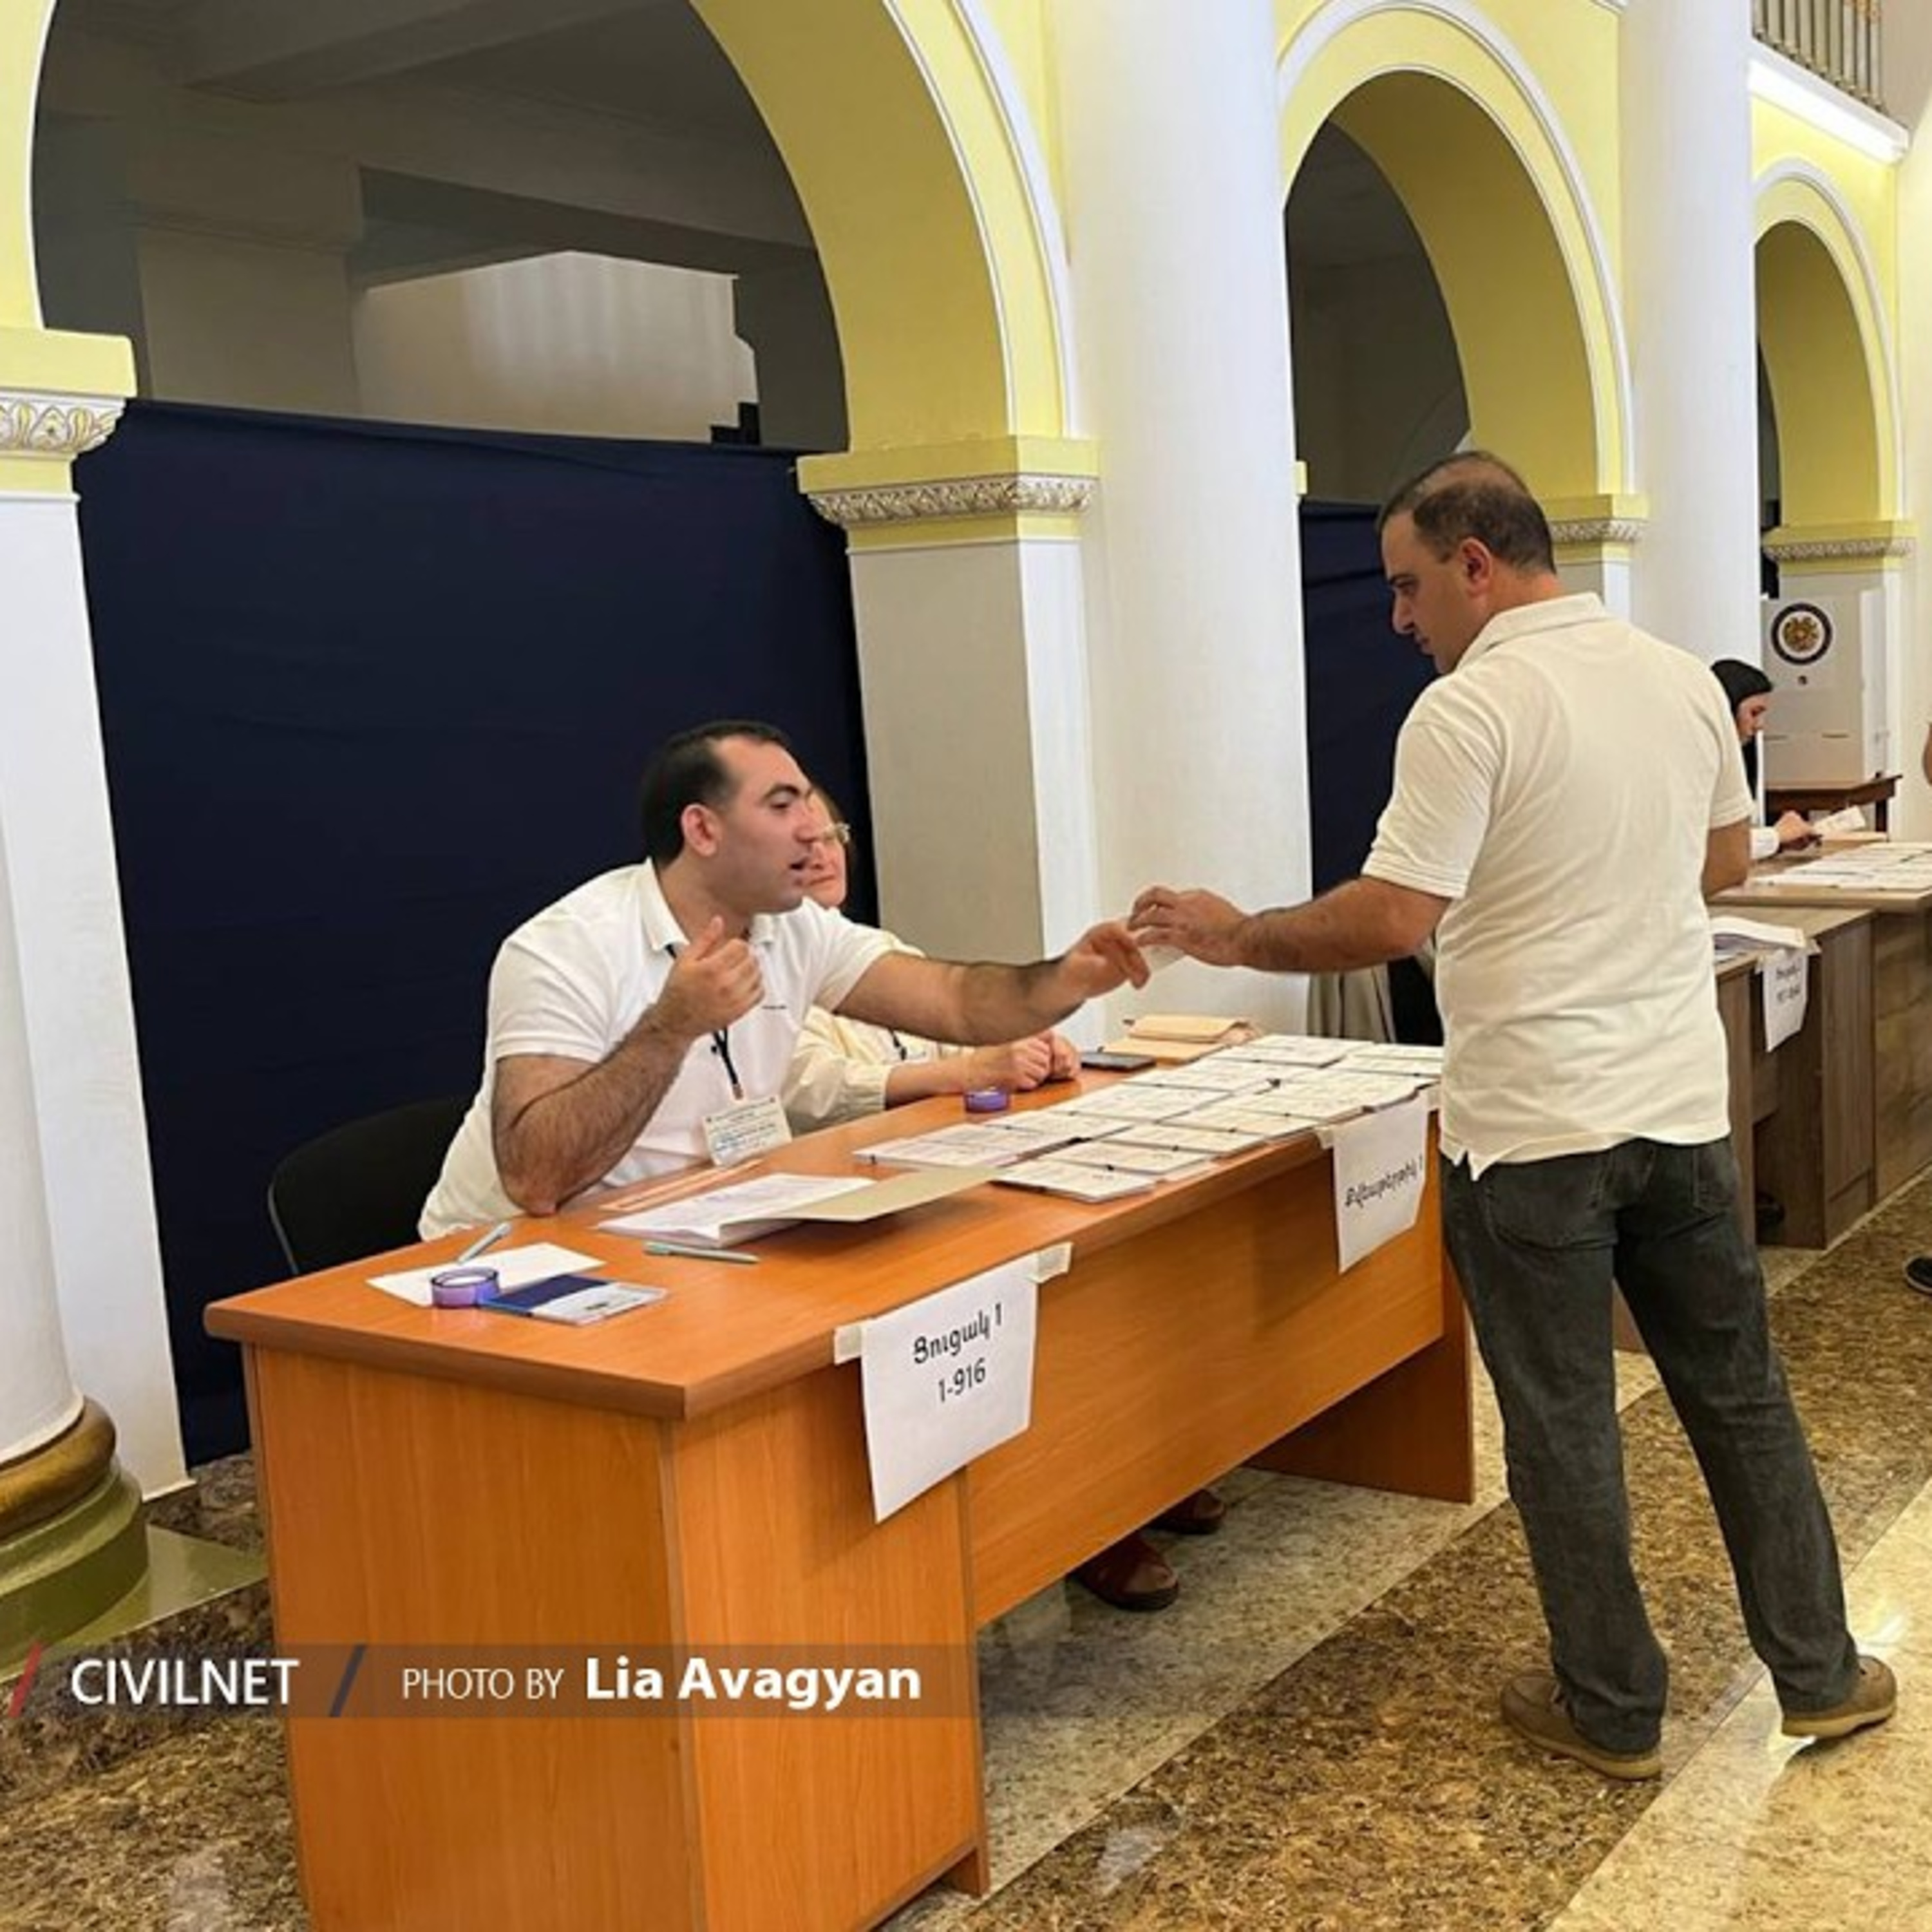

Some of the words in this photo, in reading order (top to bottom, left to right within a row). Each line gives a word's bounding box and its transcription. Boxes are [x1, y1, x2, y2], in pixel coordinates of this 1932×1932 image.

[913, 1310, 990, 1364] Ցուցակ
[995, 1303, 1002, 1326] 1
[938, 1357, 987, 1403] 1-916
